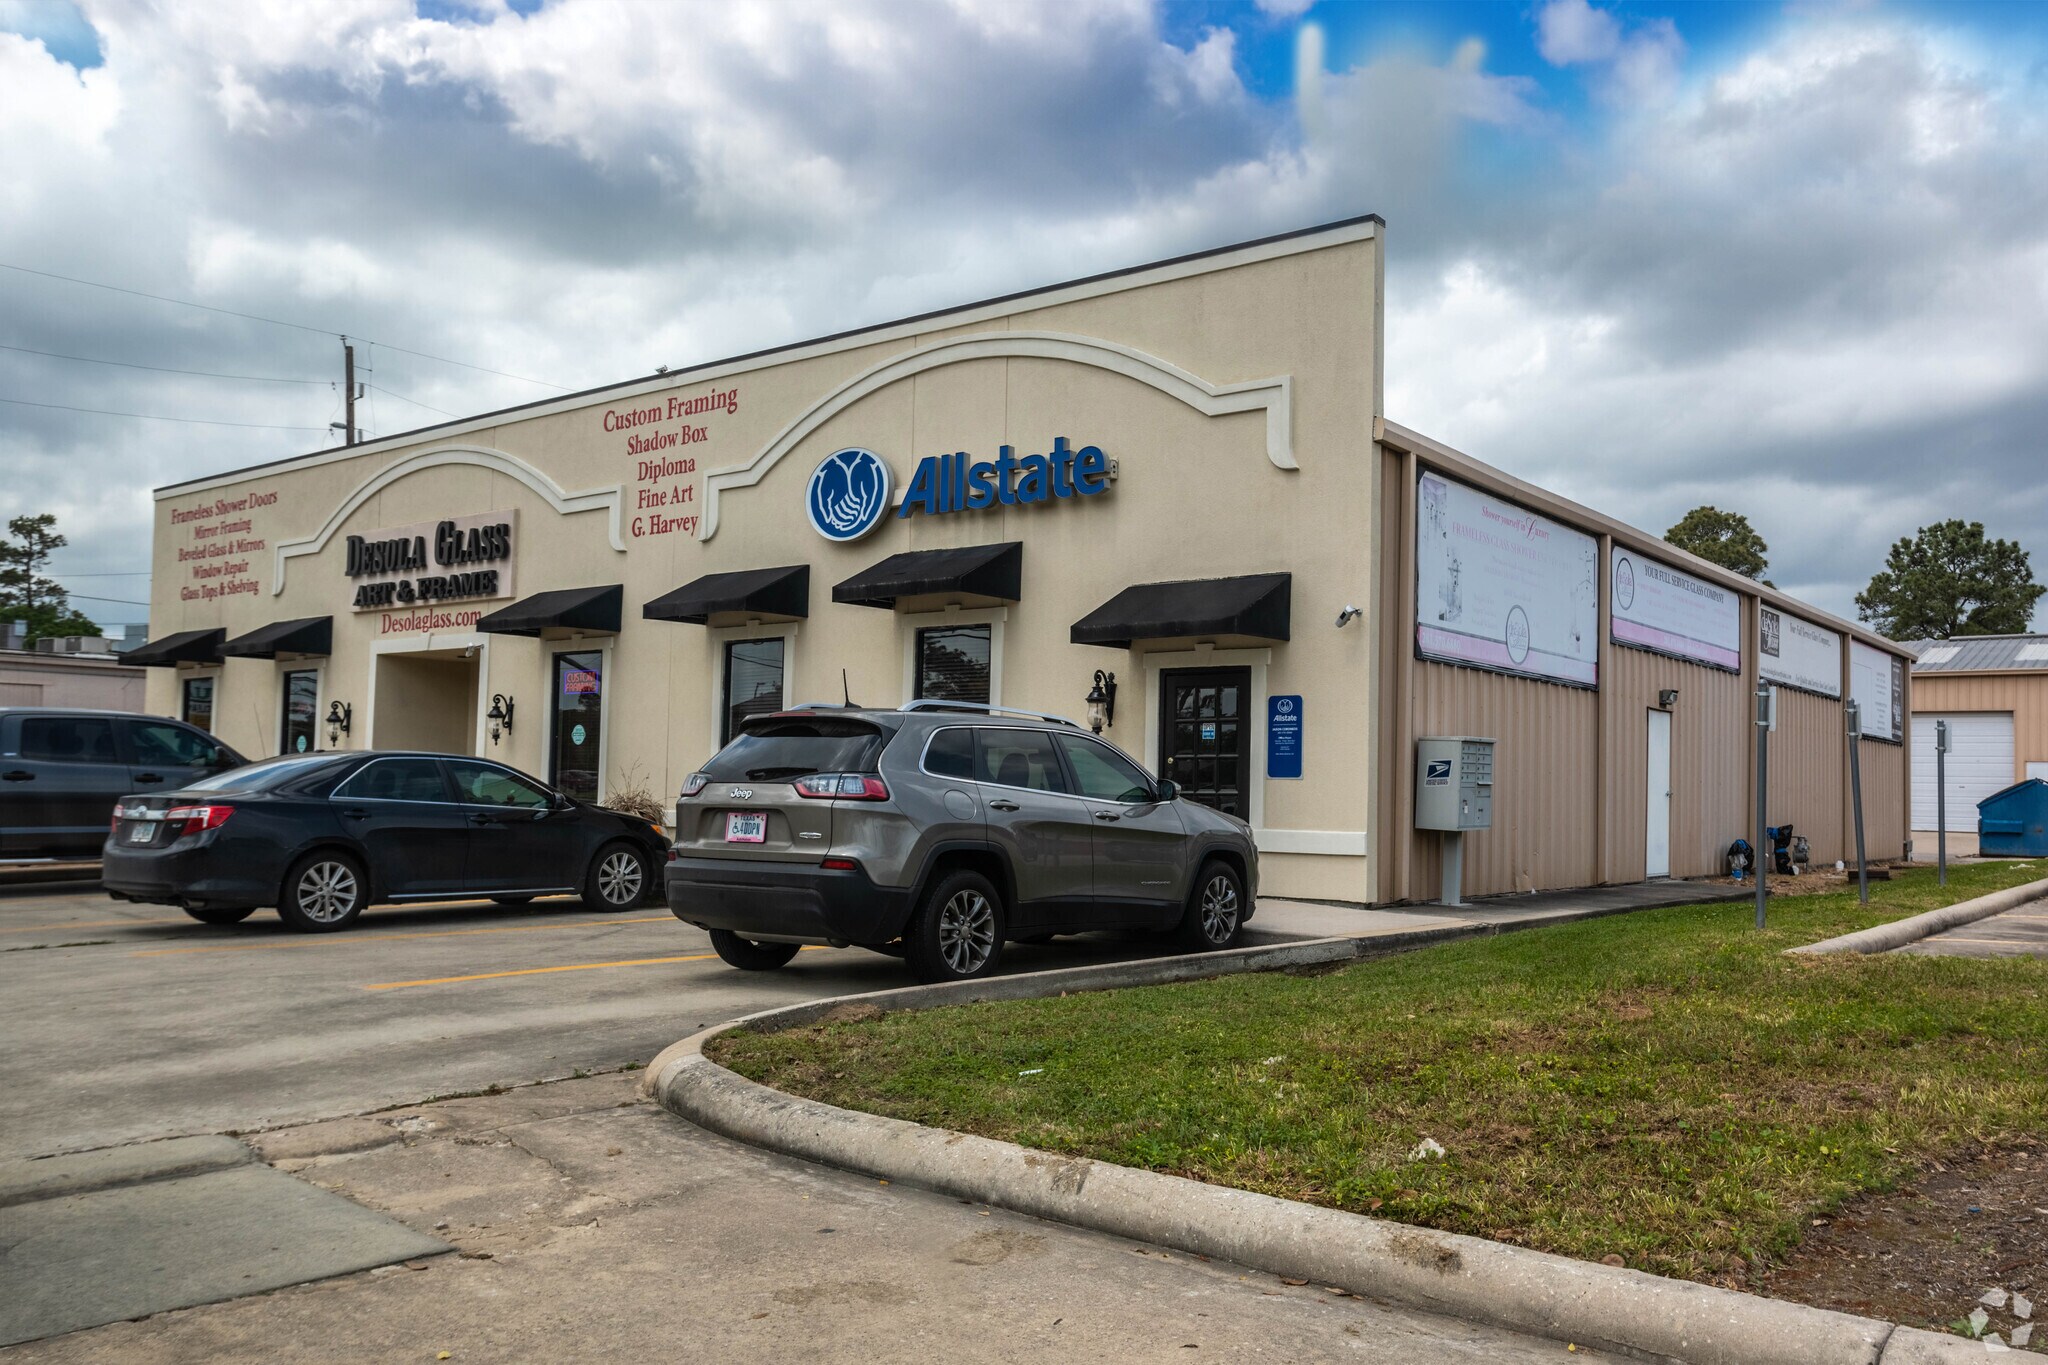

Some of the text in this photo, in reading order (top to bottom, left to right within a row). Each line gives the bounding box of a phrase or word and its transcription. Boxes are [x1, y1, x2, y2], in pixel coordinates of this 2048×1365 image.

[604, 388, 738, 432] Custom Framing
[627, 424, 708, 456] Shadow Box
[637, 457, 696, 484] Diploma
[896, 436, 1111, 519] Allstate
[171, 492, 278, 525] Frameless Shower Doors
[637, 484, 694, 509] Fine Art
[220, 518, 252, 534] Framing
[632, 514, 698, 537] G. Harvey
[207, 543, 227, 557] Glass
[345, 521, 512, 577] DESOLA GLASS
[353, 569, 499, 607] ART & FRAME
[381, 608, 482, 634] Desolaglass.com
[1273, 714, 1298, 722] Allstate
[730, 787, 753, 800] Jeep
